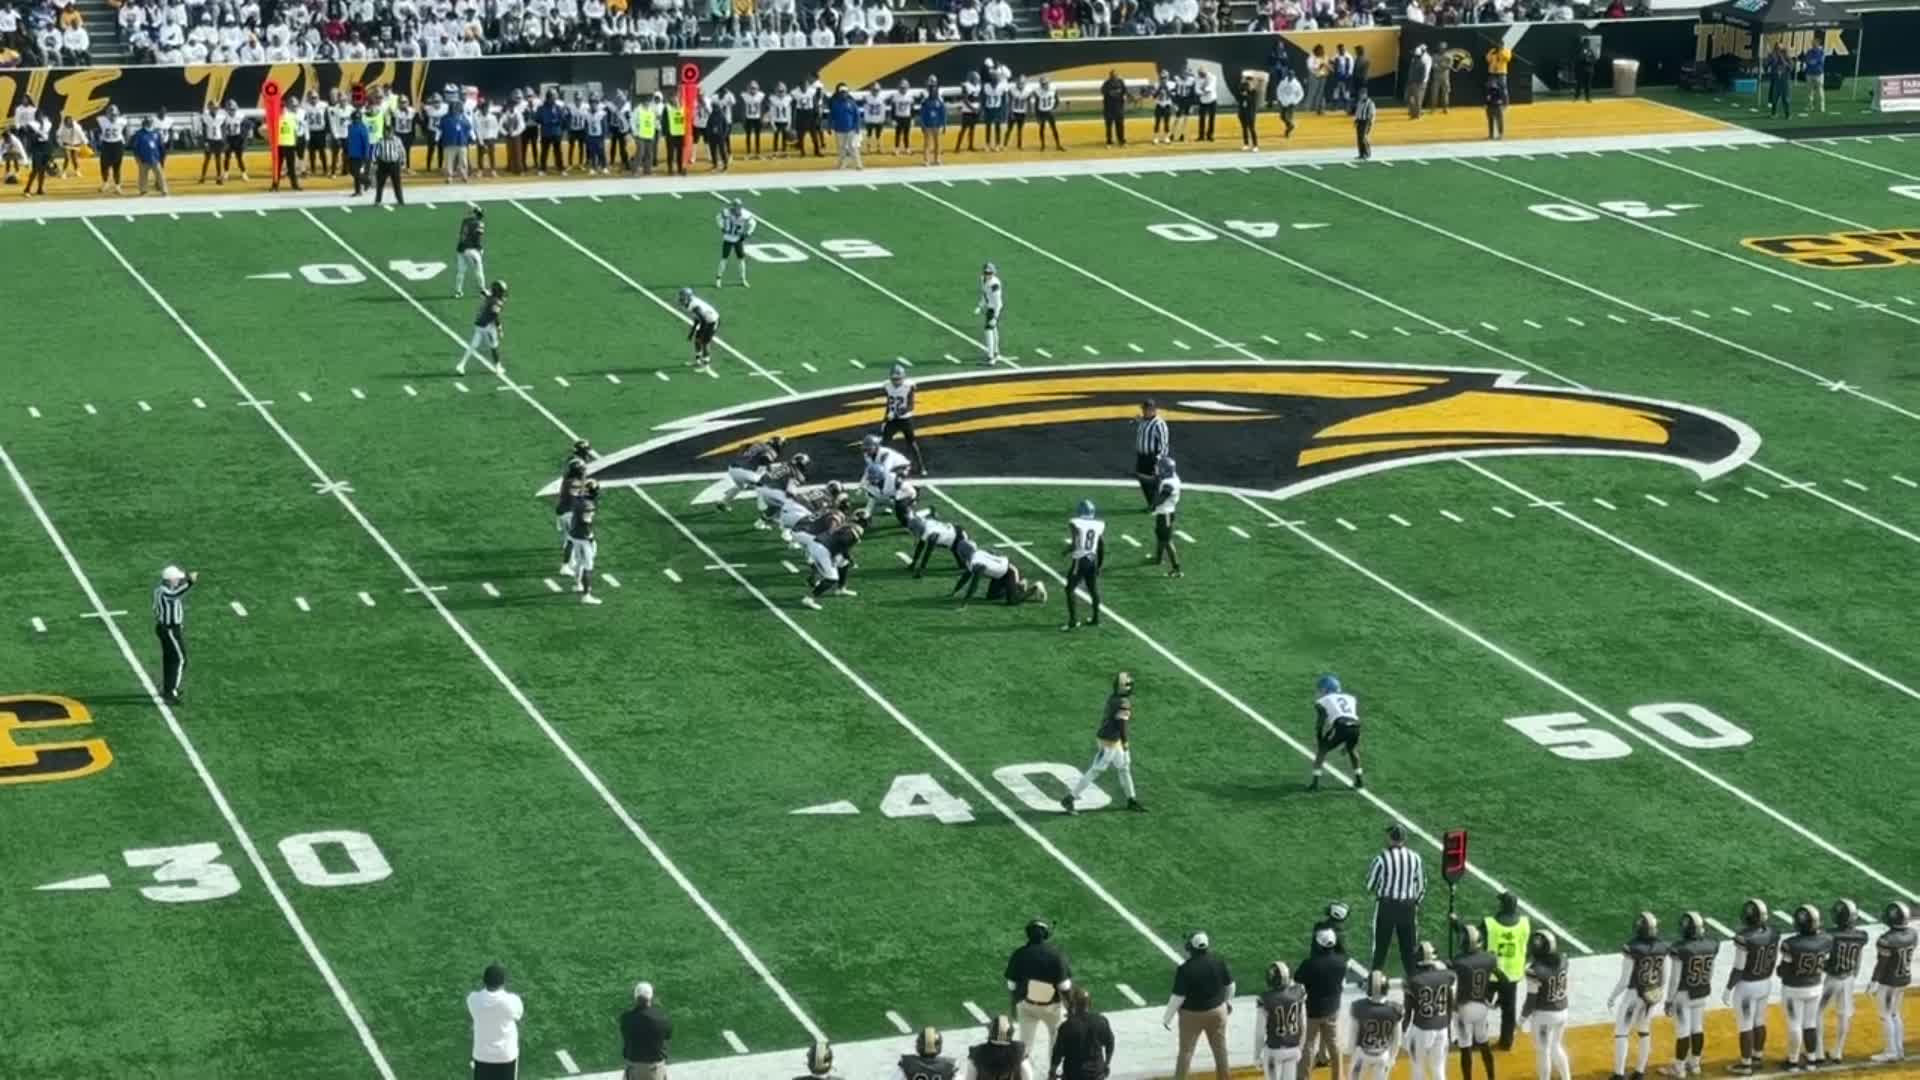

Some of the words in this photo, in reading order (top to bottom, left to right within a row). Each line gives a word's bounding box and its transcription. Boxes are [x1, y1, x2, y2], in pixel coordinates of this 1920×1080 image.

[1084, 529, 1096, 551] 8
[1337, 697, 1353, 713] 2
[1471, 968, 1487, 999] 9
[1686, 953, 1713, 986] 55
[1417, 983, 1448, 1018] 24
[1274, 1001, 1298, 1037] 14
